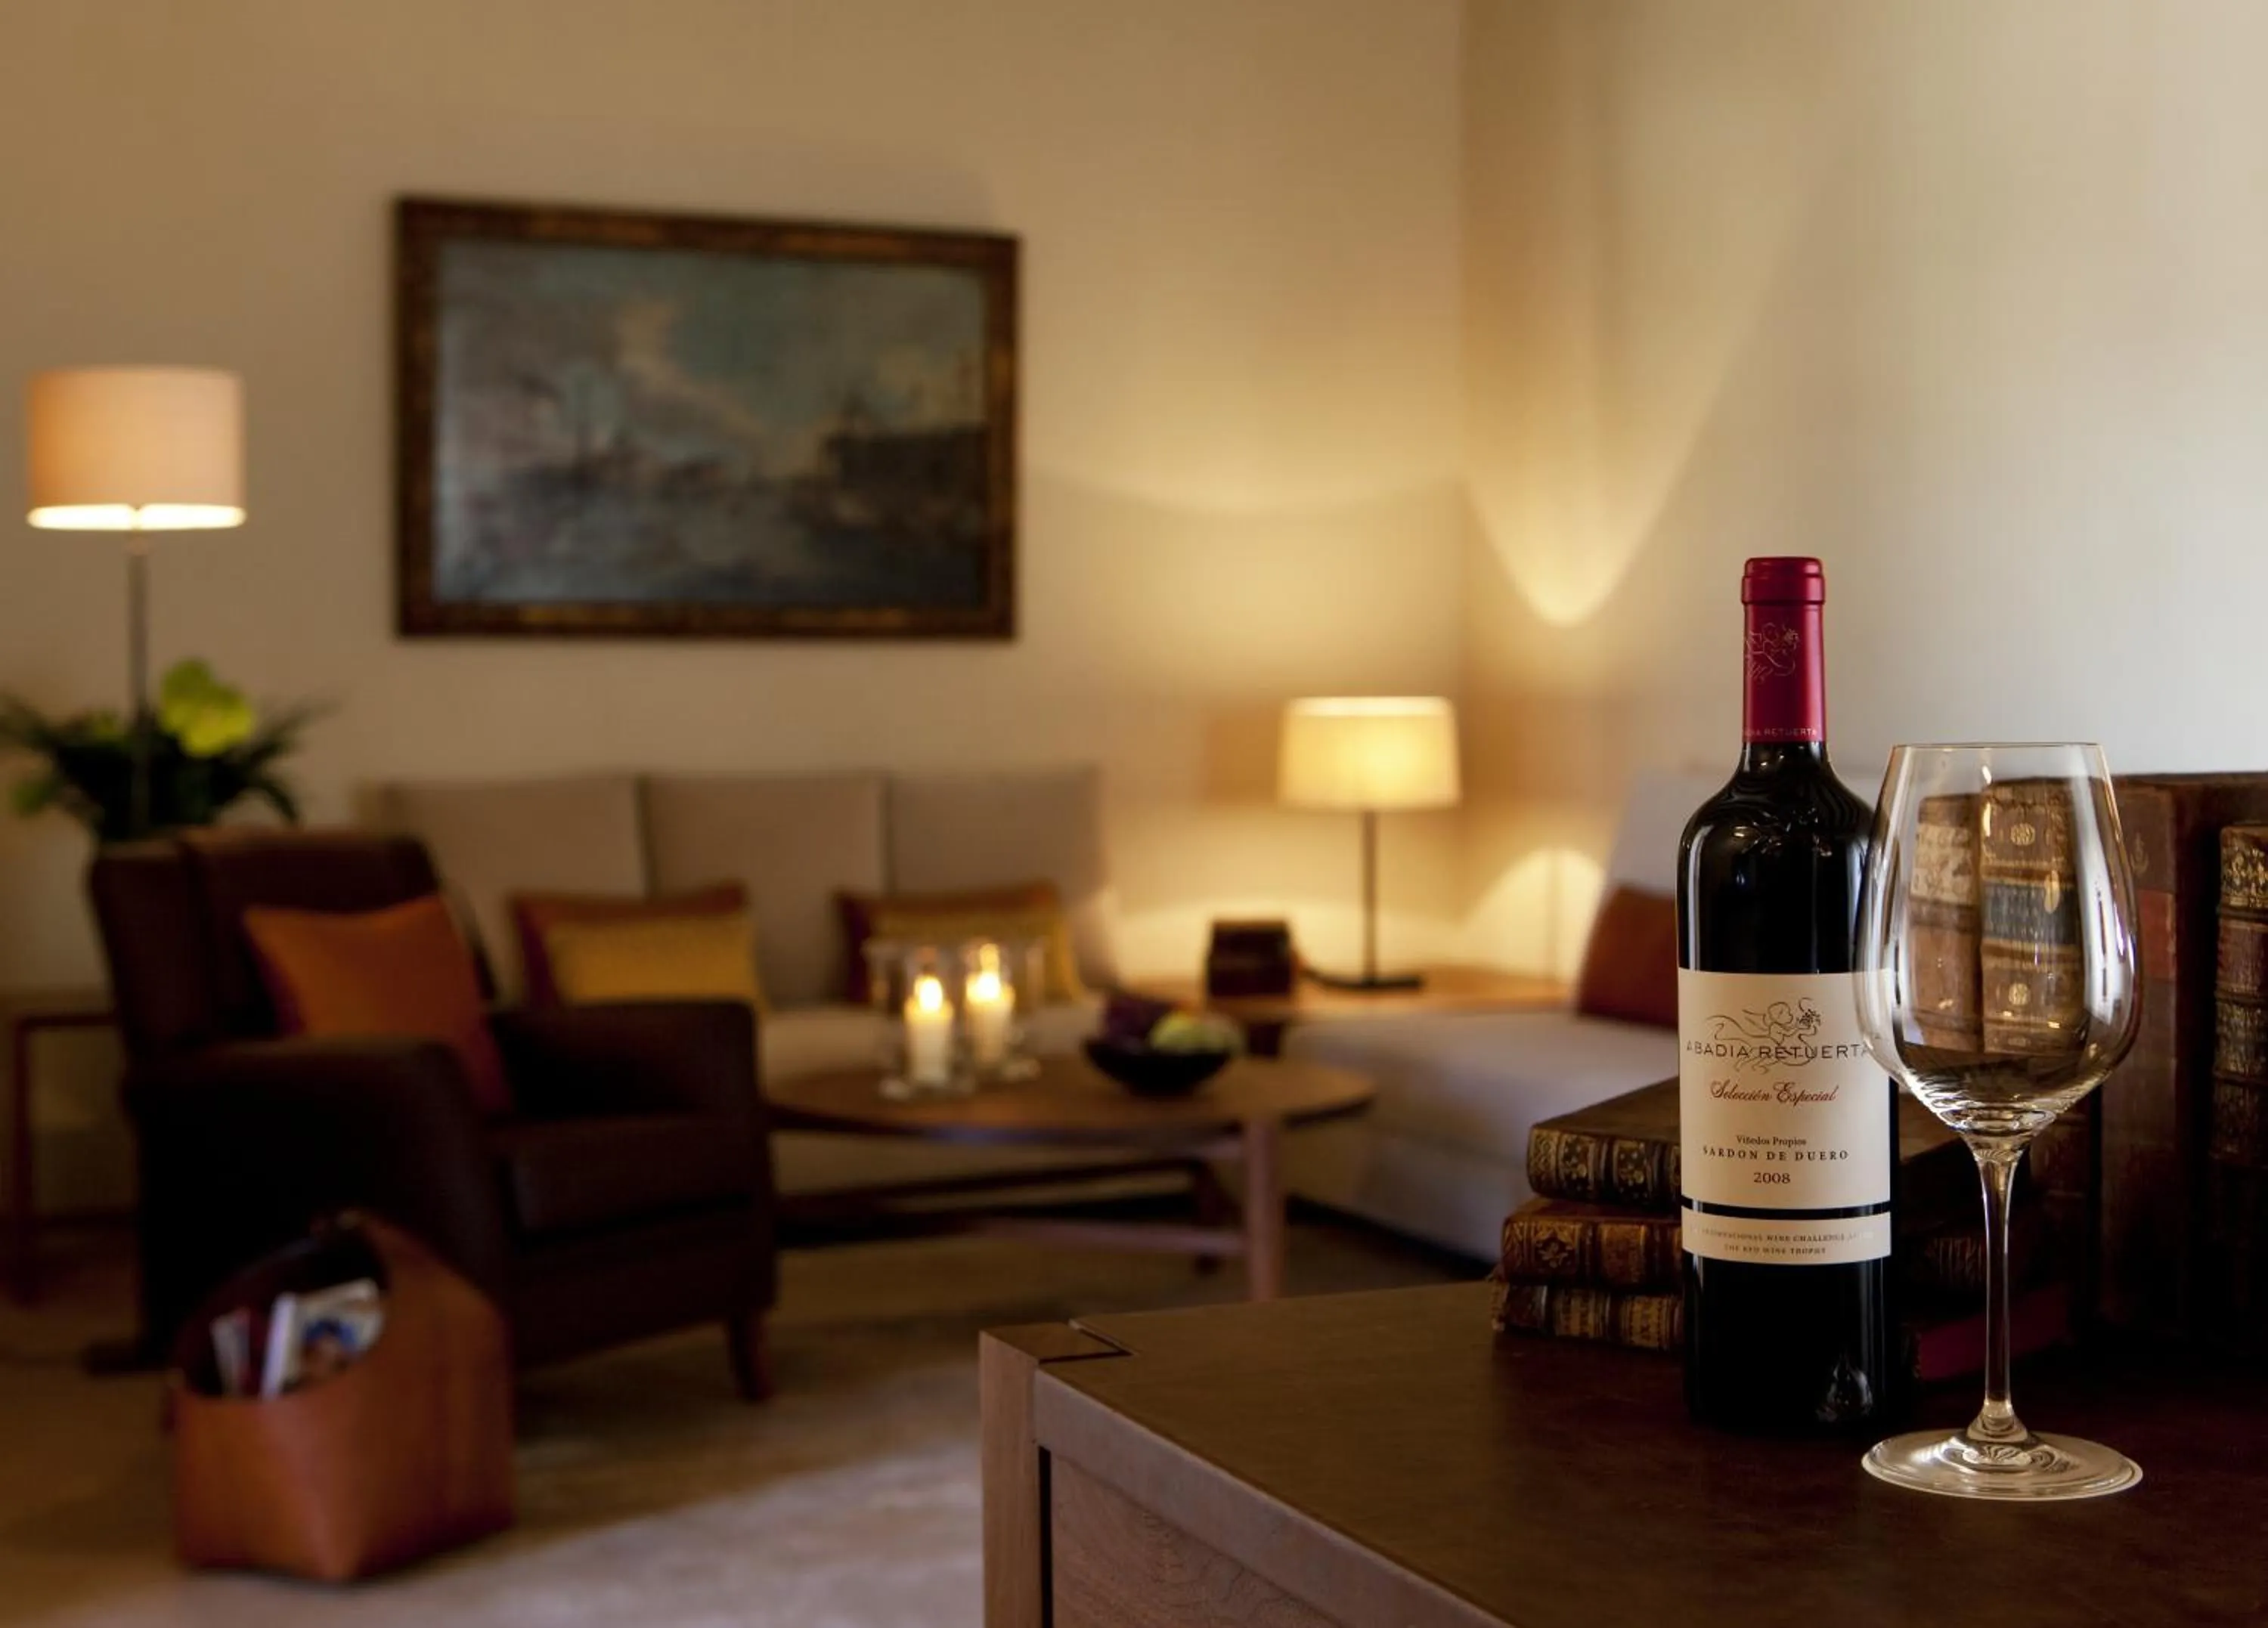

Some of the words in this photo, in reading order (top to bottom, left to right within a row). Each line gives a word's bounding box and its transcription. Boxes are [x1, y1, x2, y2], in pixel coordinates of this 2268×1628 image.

[1686, 1039, 1749, 1059] ABADIA
[1758, 1043, 1869, 1060] RETUERTA
[1773, 1081, 1839, 1107] Especial
[1736, 1134, 1770, 1146] Viñedos
[1772, 1136, 1807, 1148] Propios
[1766, 1151, 1787, 1161] DE
[1795, 1150, 1849, 1162] DUERO
[1753, 1171, 1791, 1184] 2008
[1690, 1224, 1763, 1242] TERNATIONAL
